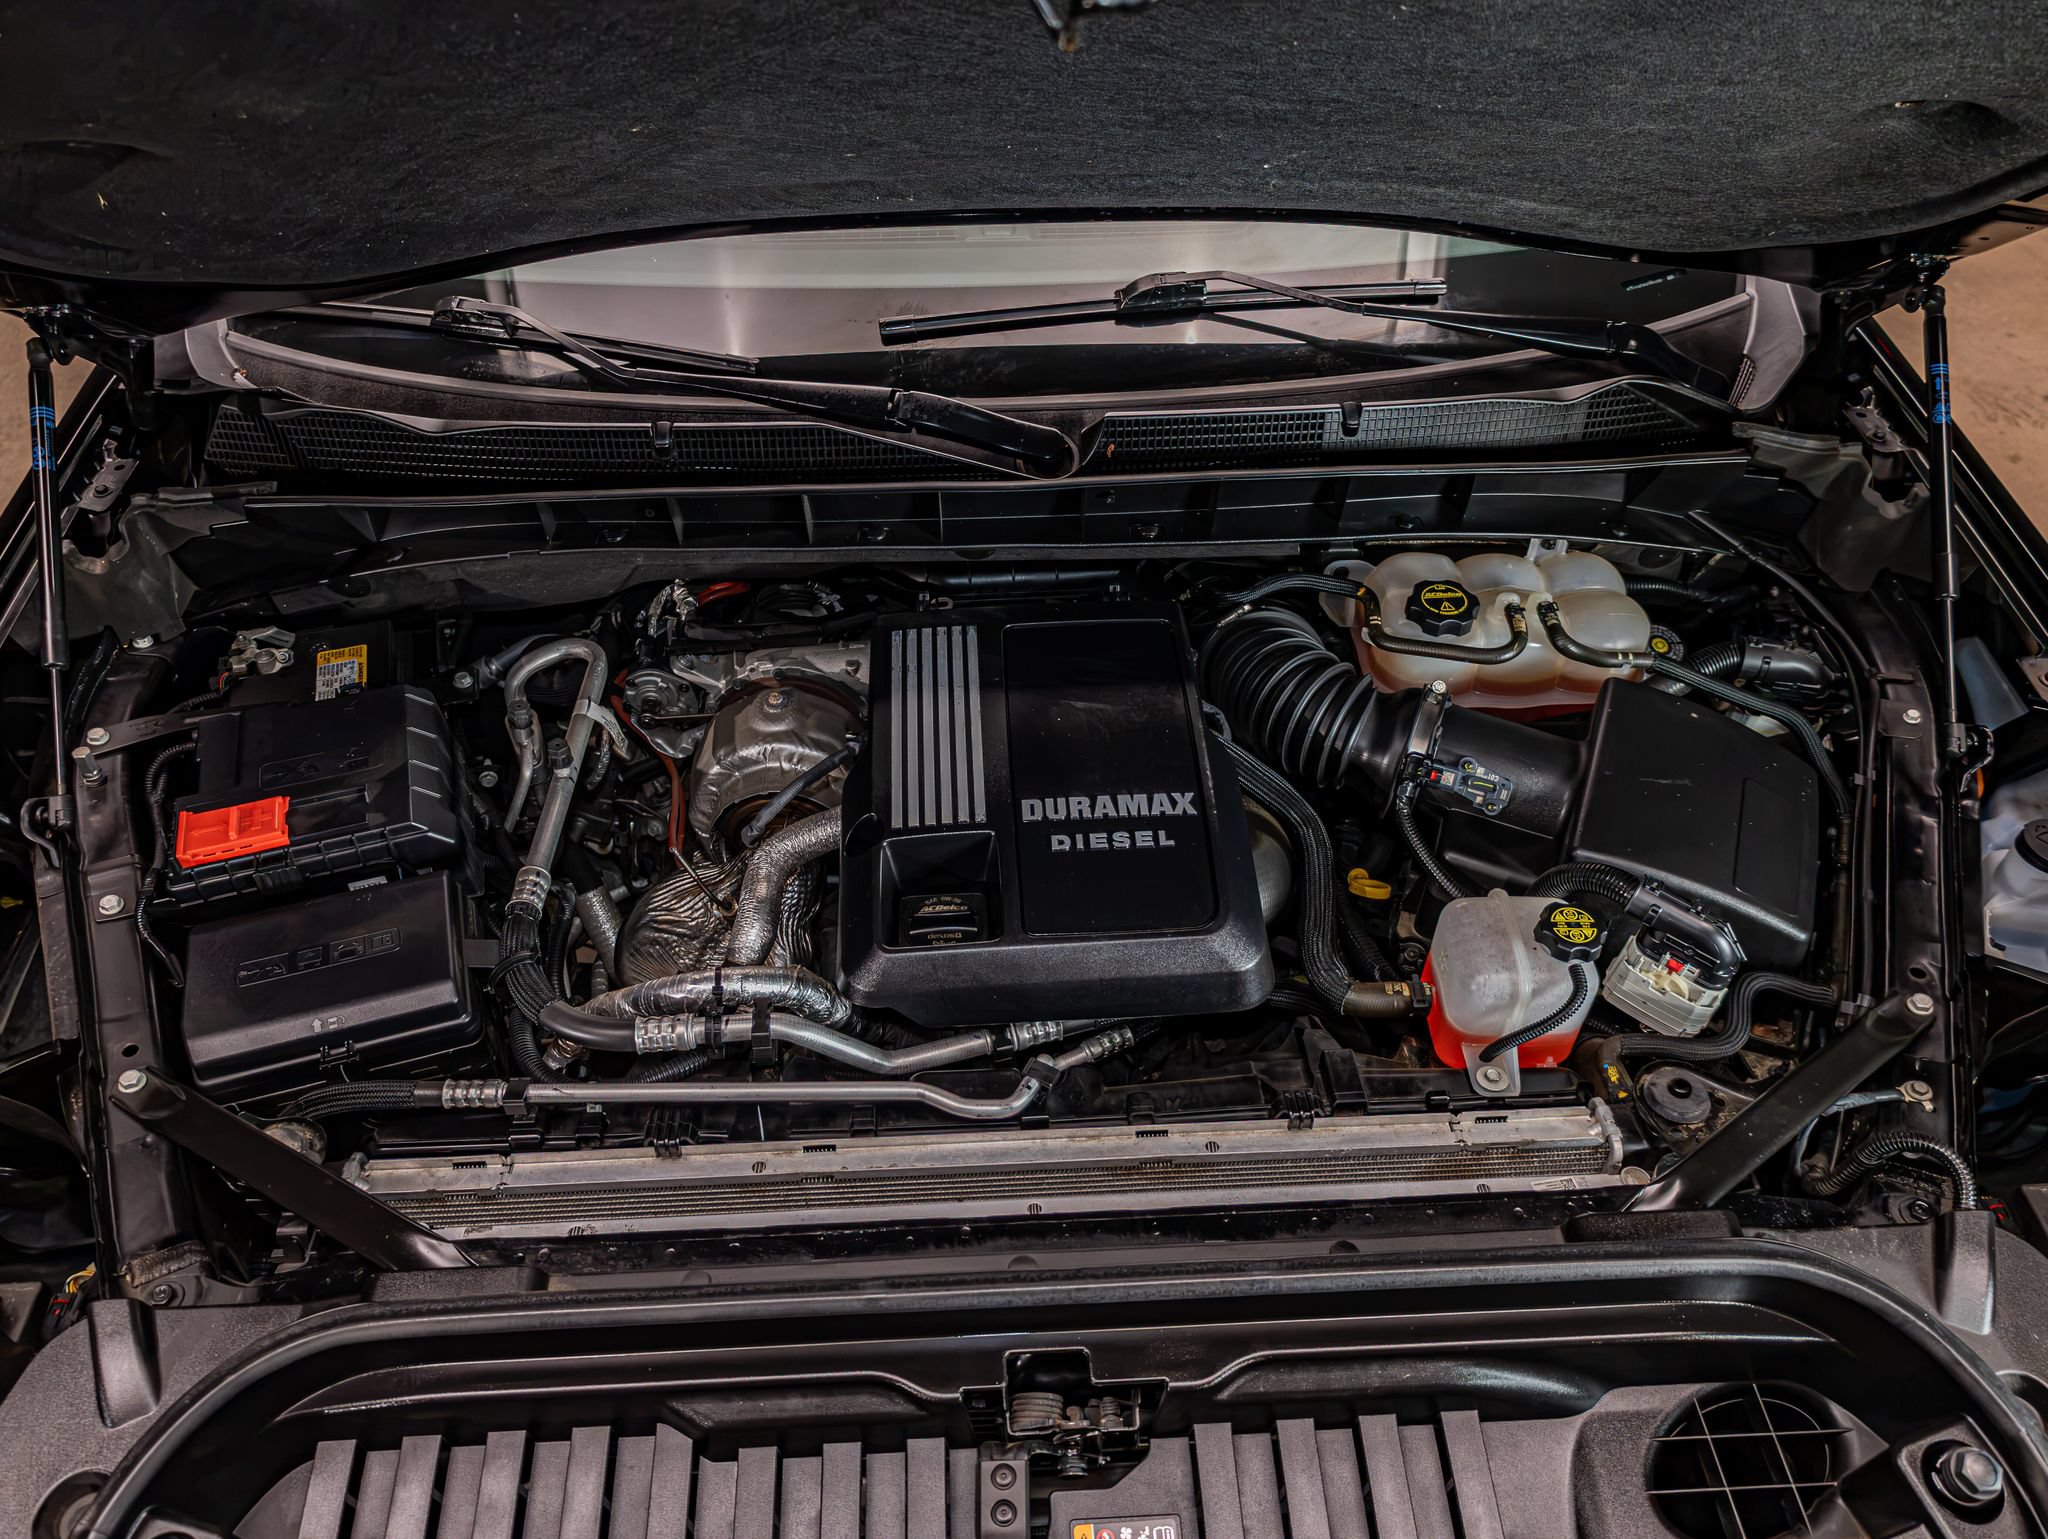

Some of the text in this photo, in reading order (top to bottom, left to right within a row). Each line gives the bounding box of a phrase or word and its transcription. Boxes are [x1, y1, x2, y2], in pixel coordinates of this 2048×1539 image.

[1021, 792, 1198, 823] DURAMAX
[1050, 830, 1176, 853] DIESEL
[919, 904, 969, 912] ACDelco
